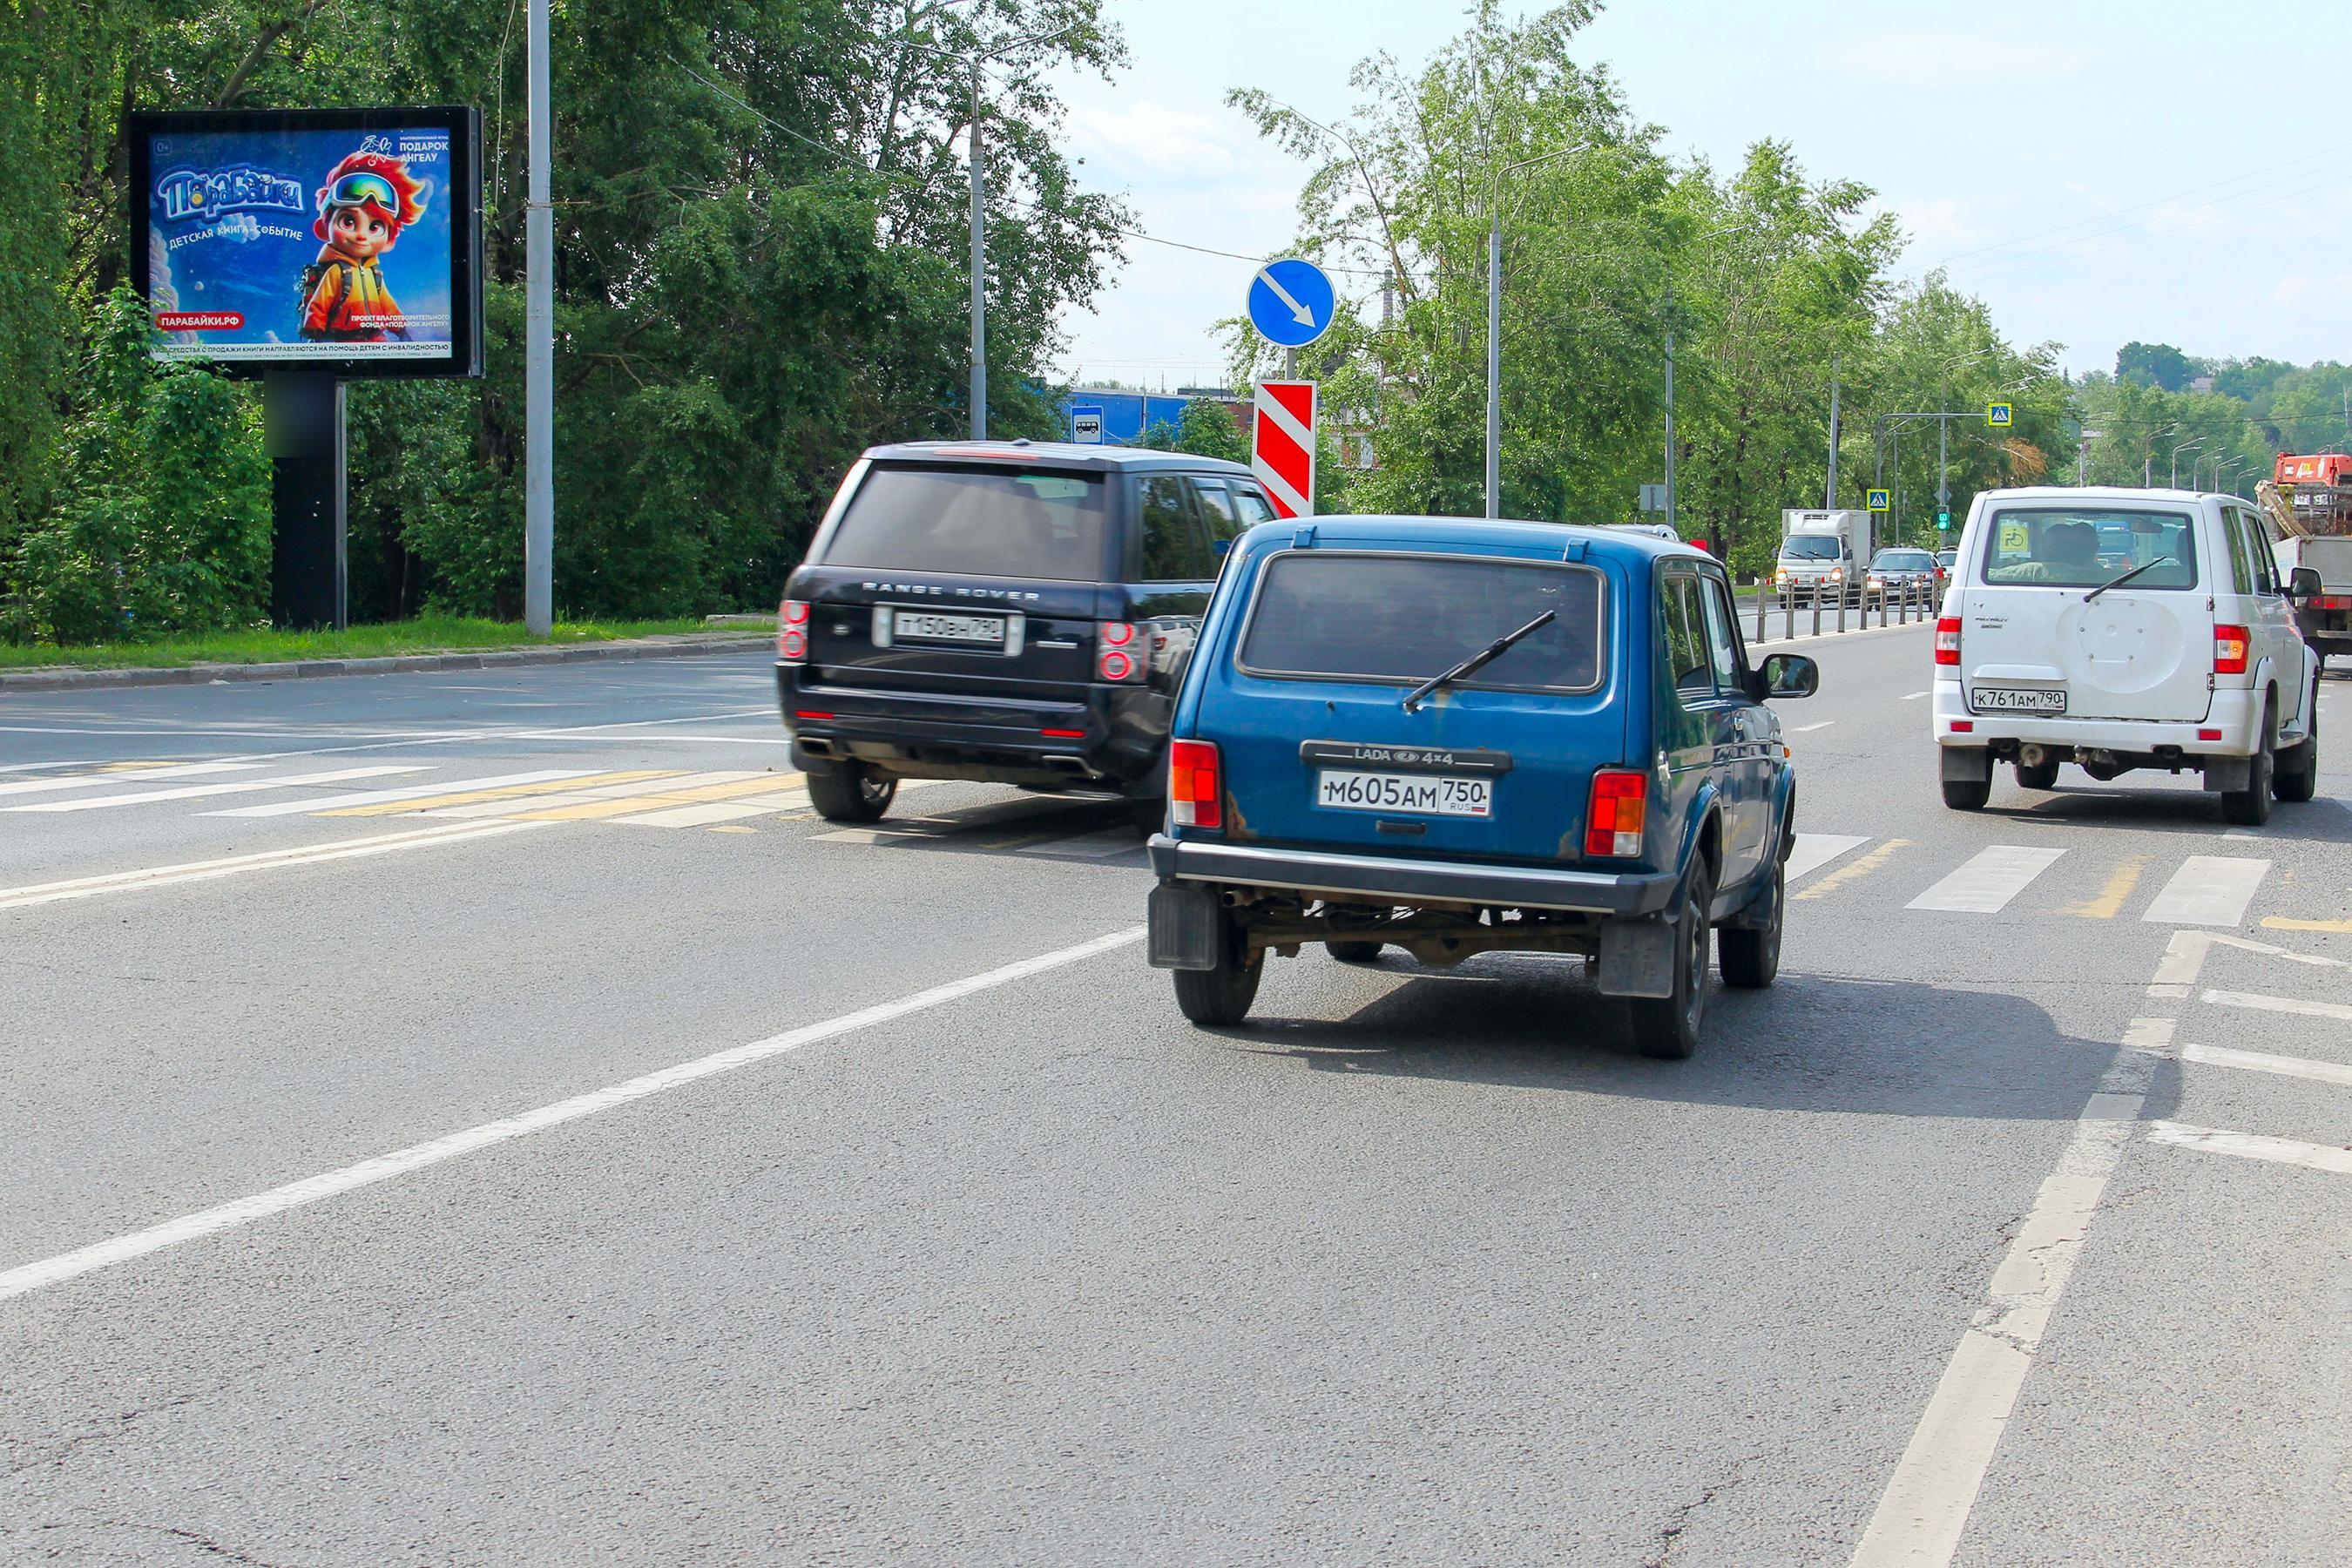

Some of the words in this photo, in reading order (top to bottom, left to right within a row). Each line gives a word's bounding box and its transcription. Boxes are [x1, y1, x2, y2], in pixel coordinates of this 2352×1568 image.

[157, 142, 169, 152] 0+
[399, 141, 449, 152] ПОДАРОК
[401, 152, 438, 163] АНГЕЛУ
[169, 229, 214, 251] ДЕТСКАЯ
[217, 224, 304, 241] КНИГА-СОБЫТИЕ
[161, 315, 240, 327] ПАРАБАЙКИ.РФ
[862, 582, 943, 595] RANGE
[956, 588, 1040, 601] ROVER
[1355, 748, 1391, 761] LADA
[1450, 802, 1470, 812] RUS
